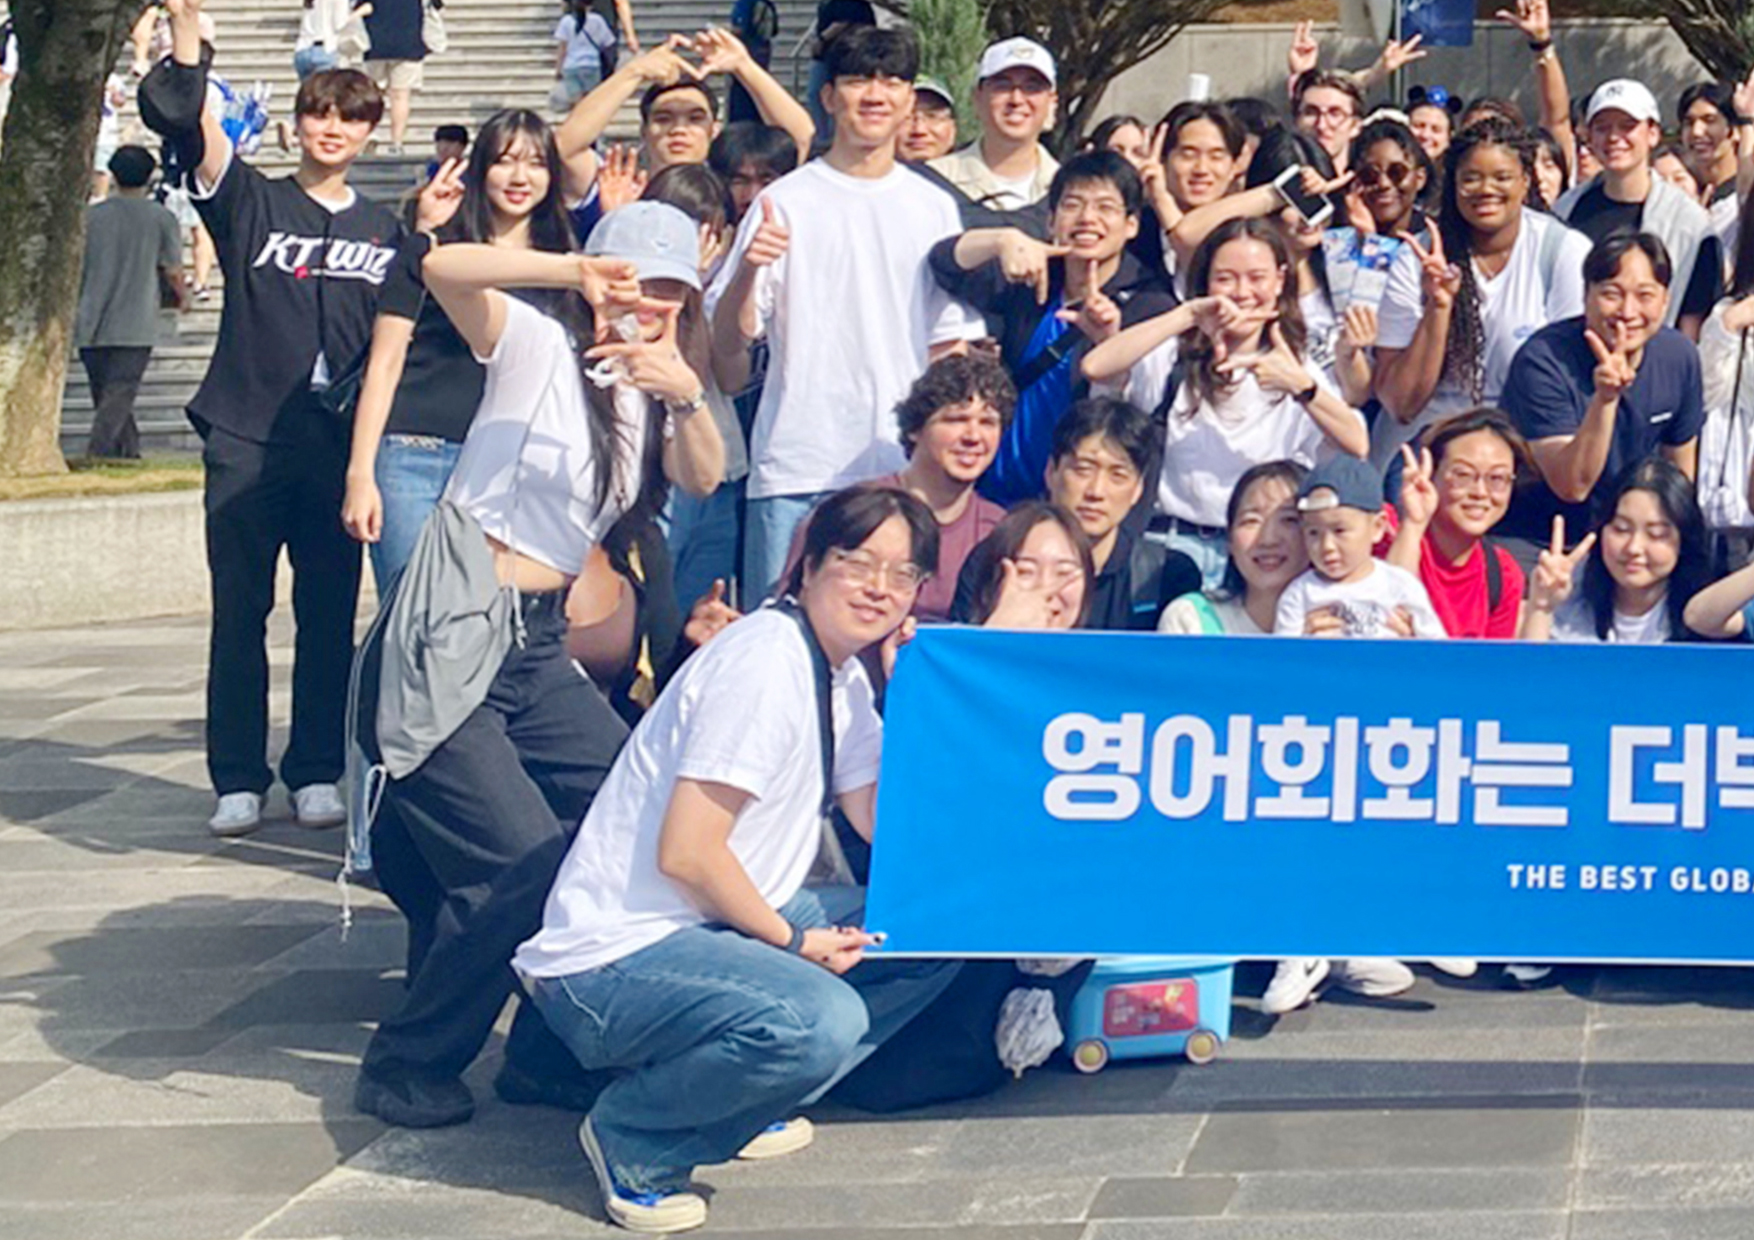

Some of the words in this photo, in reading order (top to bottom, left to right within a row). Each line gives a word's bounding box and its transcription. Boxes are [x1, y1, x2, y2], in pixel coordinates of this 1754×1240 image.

[1042, 712, 1574, 827] 영어회화는
[1507, 864, 1565, 889] THE
[1581, 865, 1656, 890] BEST
